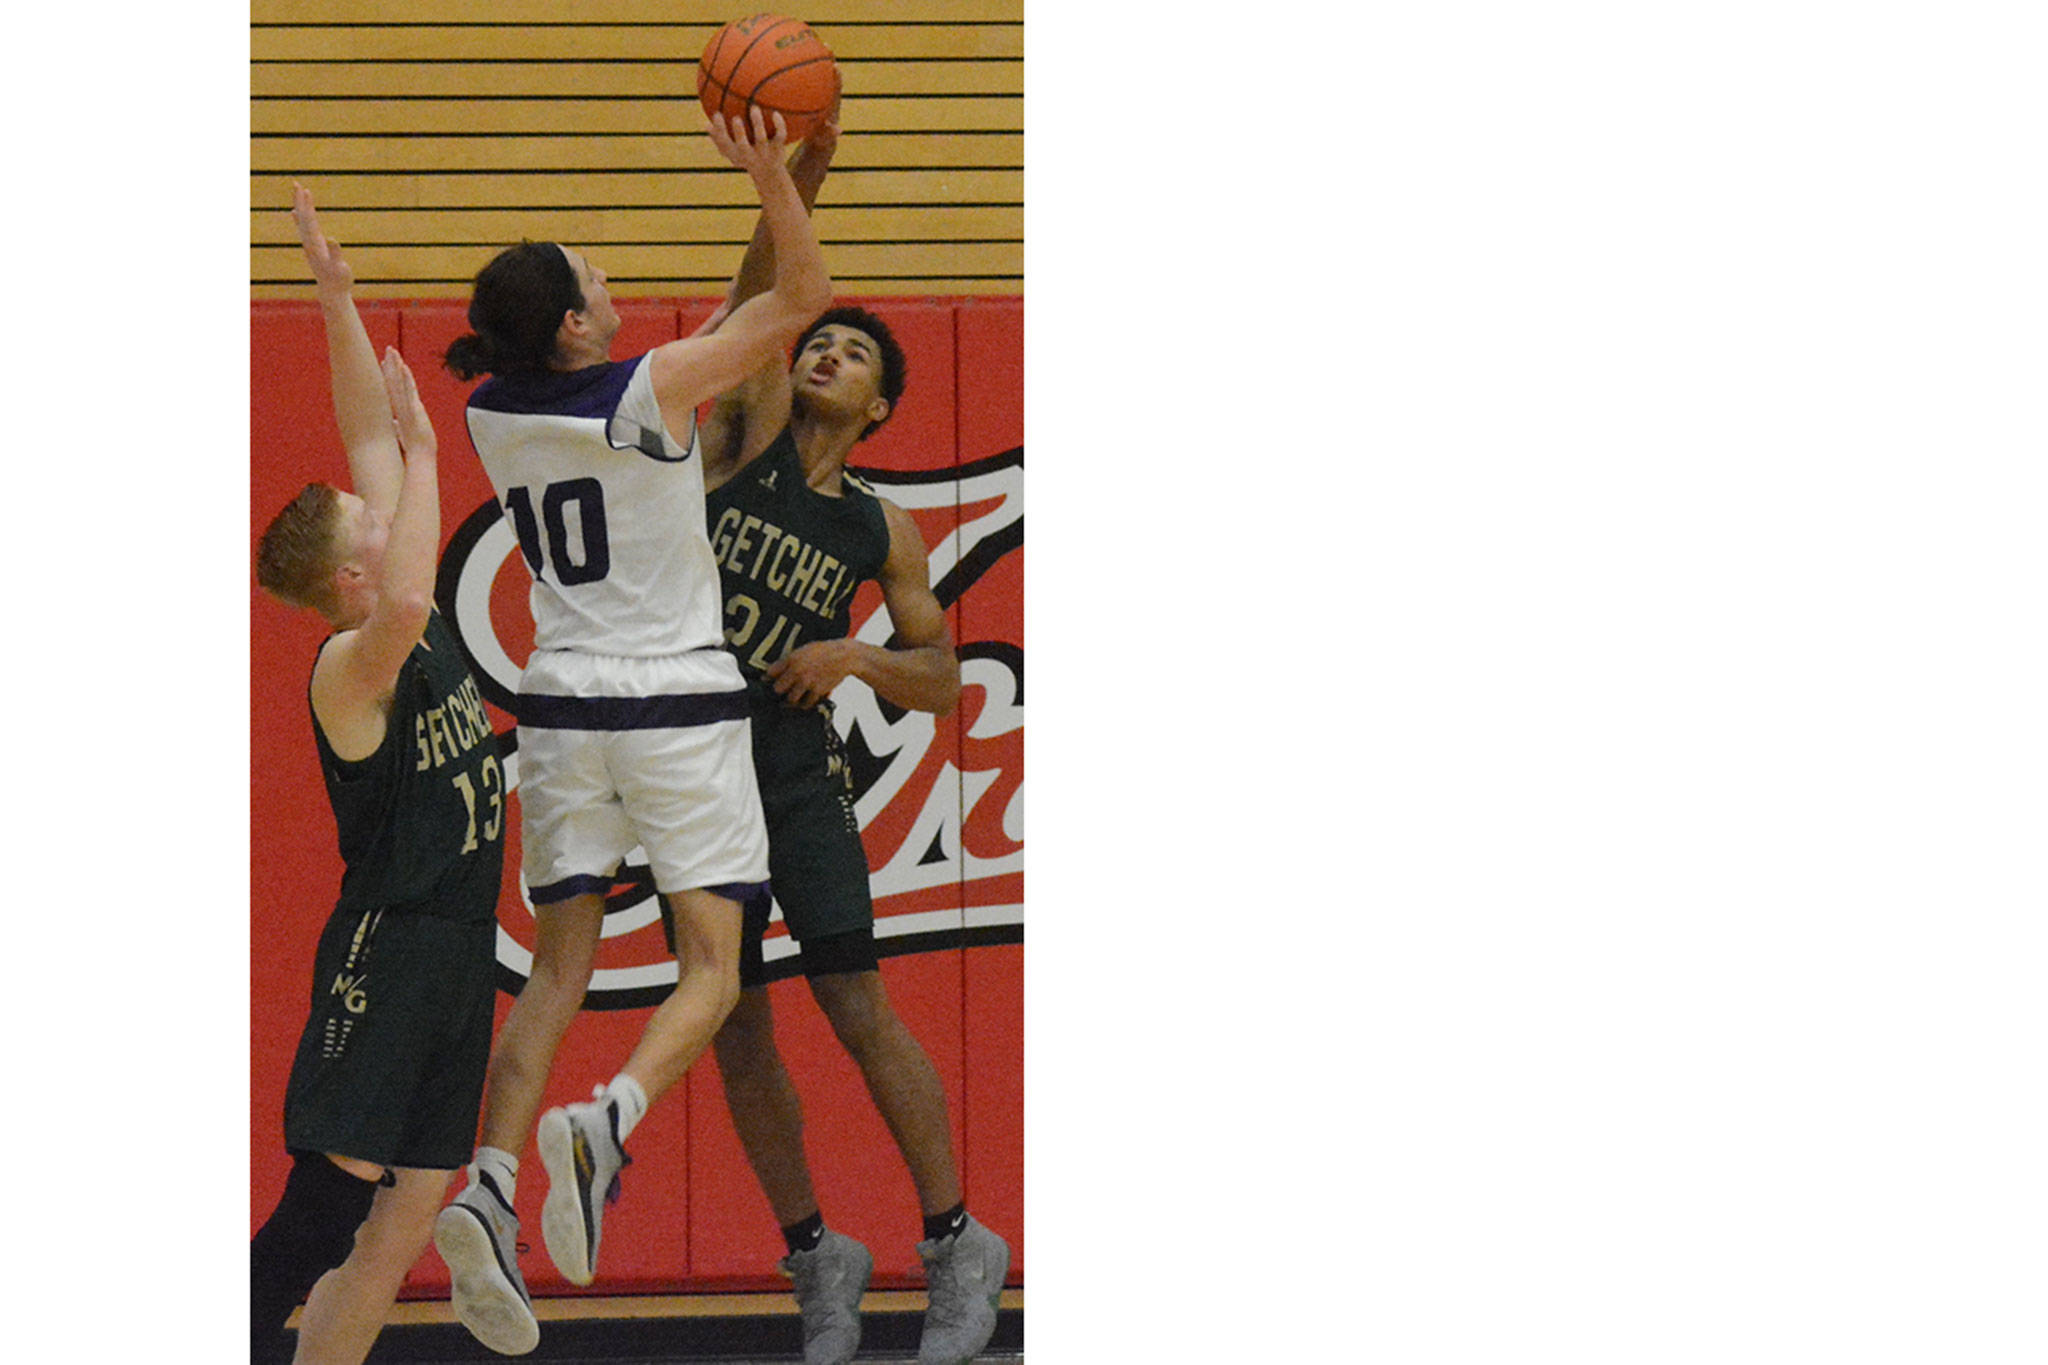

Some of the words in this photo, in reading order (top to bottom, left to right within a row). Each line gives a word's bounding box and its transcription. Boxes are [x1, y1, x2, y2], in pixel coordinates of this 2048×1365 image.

[505, 477, 610, 587] 10
[711, 507, 855, 620] GETCHEL
[452, 754, 501, 856] 13
